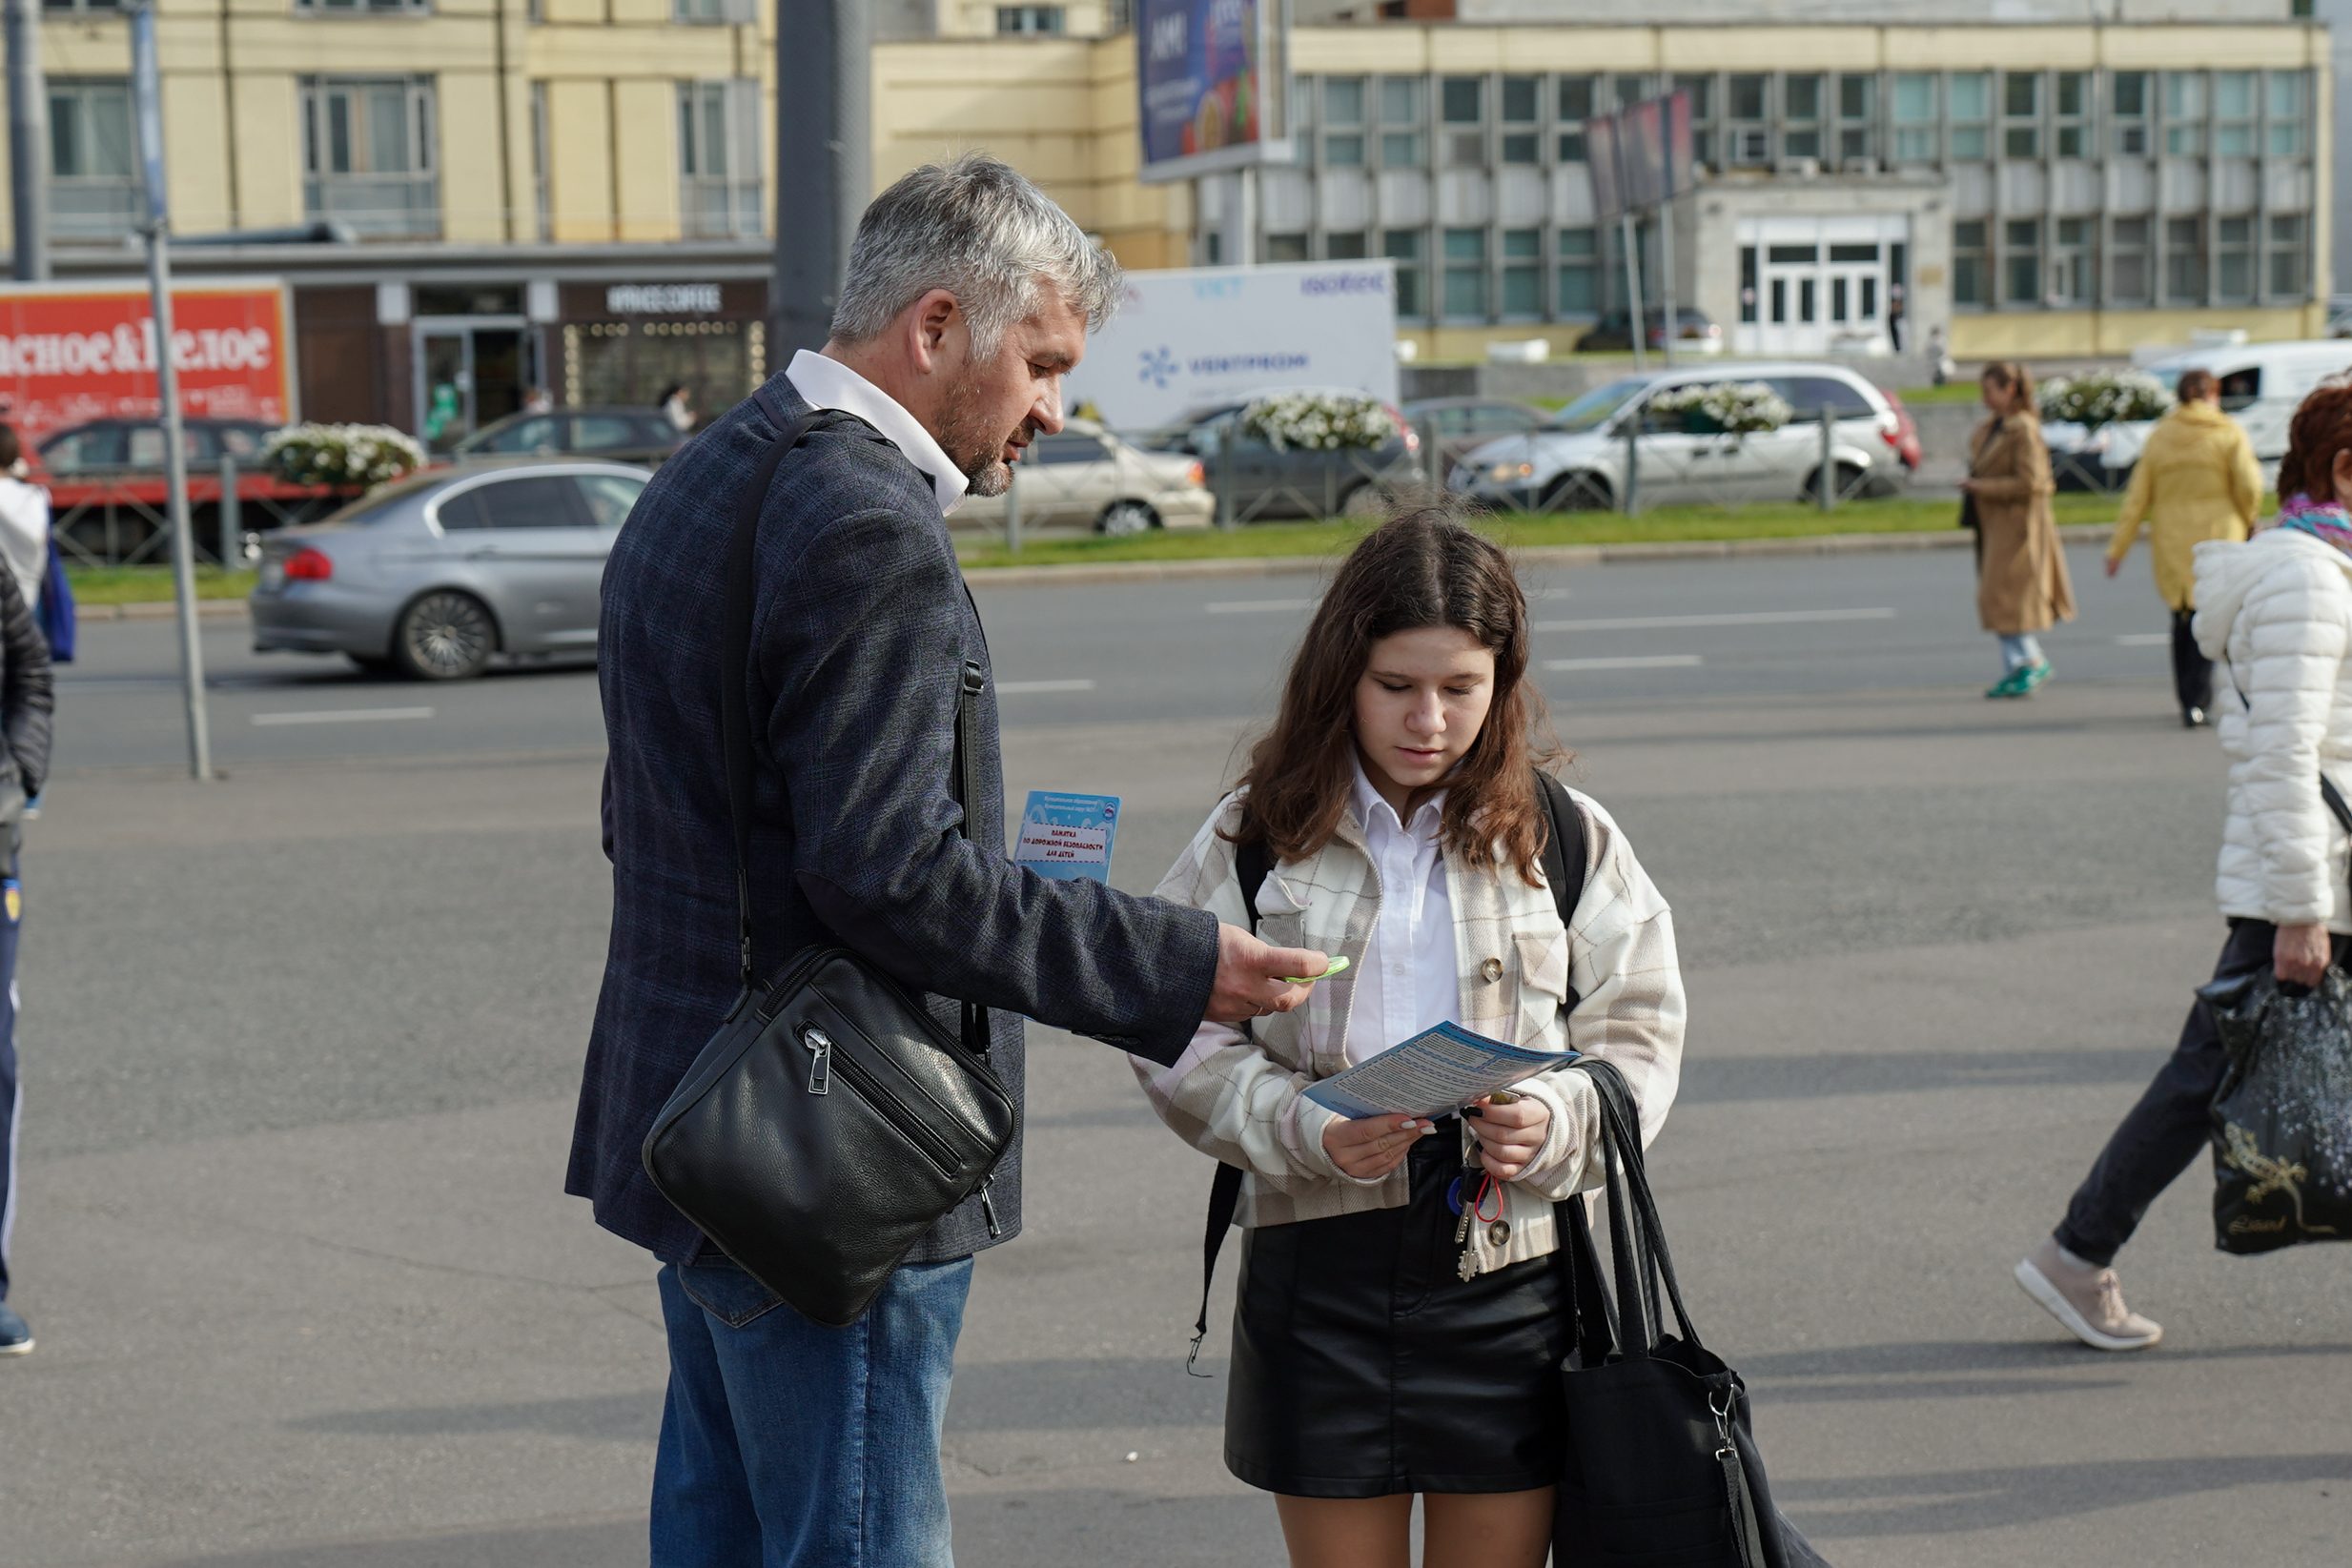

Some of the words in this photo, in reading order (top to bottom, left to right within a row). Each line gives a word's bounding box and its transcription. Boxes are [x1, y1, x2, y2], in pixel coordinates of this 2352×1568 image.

[665, 284, 723, 312] COFFEE
[1189, 353, 1308, 375] VENTPROM
[1051, 829, 1076, 838] ПАМЯТКА
[1031, 838, 1062, 846] ДОРОЖНОЙ
[1058, 849, 1074, 858] ДЕТЕЙ
